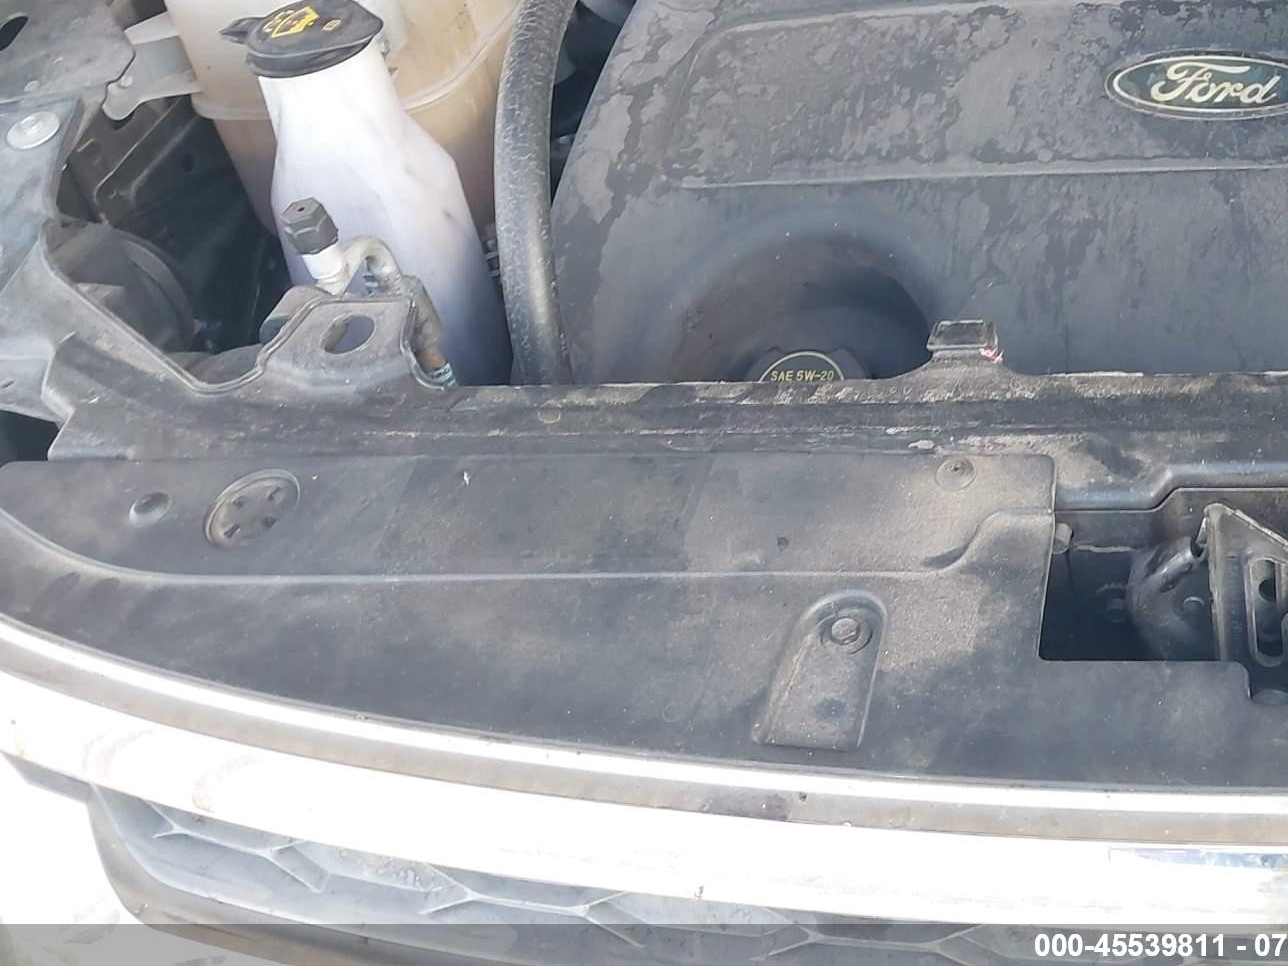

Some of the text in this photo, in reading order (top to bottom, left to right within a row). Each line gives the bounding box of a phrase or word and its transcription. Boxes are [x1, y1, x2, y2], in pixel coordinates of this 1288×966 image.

[1150, 61, 1281, 105] Ford
[770, 370, 834, 382] SAE 5W-20
